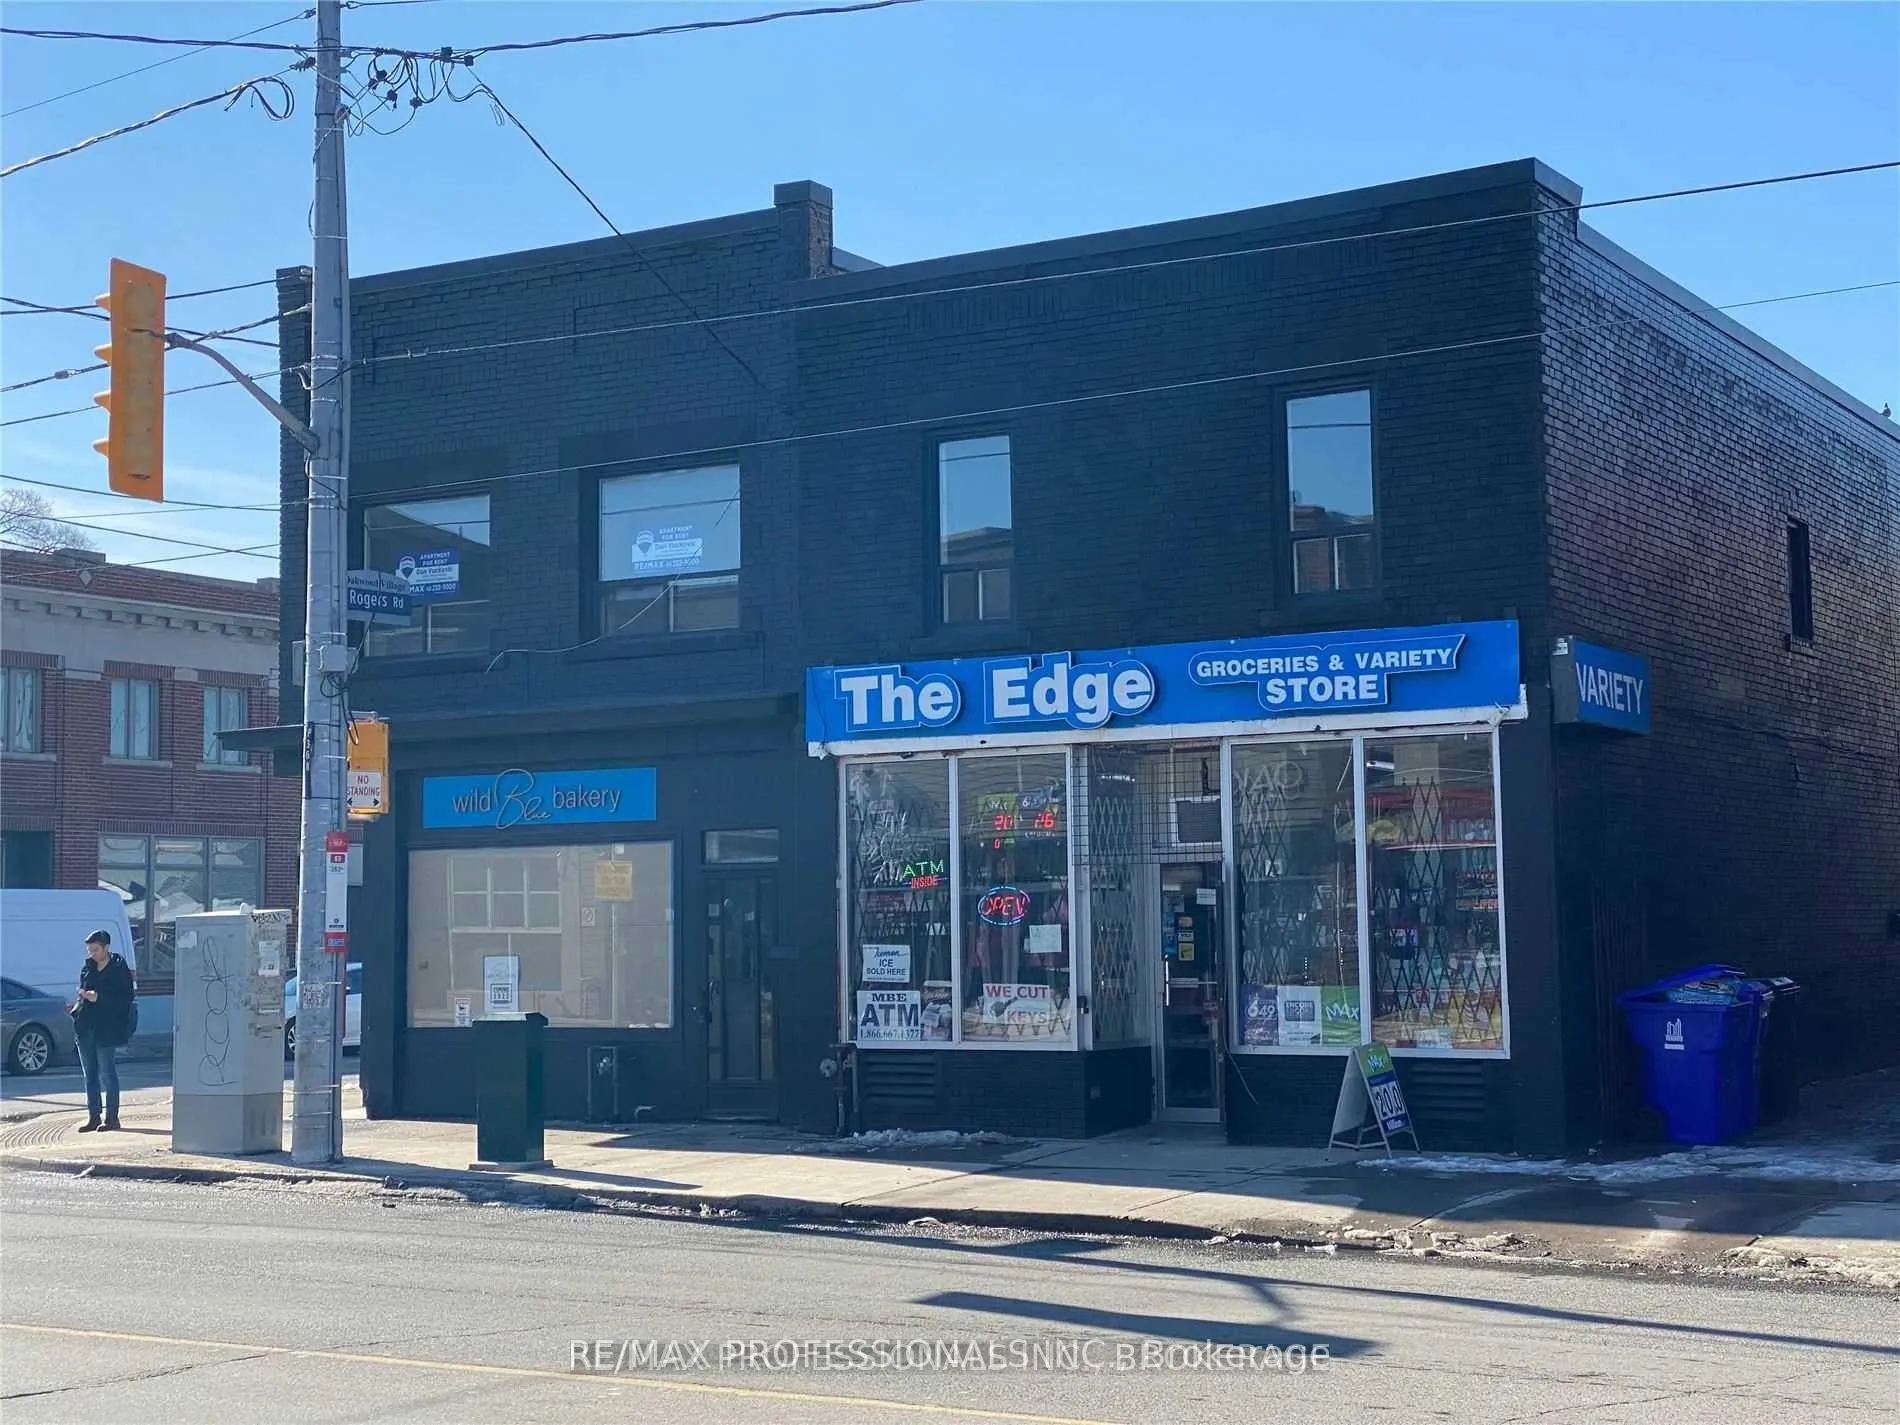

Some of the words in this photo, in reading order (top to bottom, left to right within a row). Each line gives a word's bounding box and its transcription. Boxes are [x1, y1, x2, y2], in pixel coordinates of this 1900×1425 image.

[349, 589, 388, 609] Rogers
[392, 597, 404, 609] Rd
[1196, 655, 1319, 678] GROCERIES
[1328, 654, 1344, 670] &
[1354, 647, 1452, 669] VARIETY
[841, 673, 953, 725] The
[992, 662, 1153, 724] Edge
[1266, 674, 1379, 705] STORE
[1575, 661, 1643, 715] VARIETY
[357, 775, 369, 785] NO
[453, 787, 491, 813] wild
[495, 768, 551, 830] Blue
[553, 783, 621, 814] bakery
[902, 859, 944, 878] ATM
[911, 874, 941, 889] INSIDE
[980, 896, 1027, 916] OPEN
[880, 958, 894, 968] ICE
[887, 968, 906, 976] HERE
[871, 993, 907, 1002] MBE
[985, 985, 1012, 998] WE
[1016, 985, 1048, 999] CUT
[860, 1003, 920, 1028] ATM
[1007, 1010, 1048, 1024] KEYS
[1325, 1002, 1360, 1021] MAX
